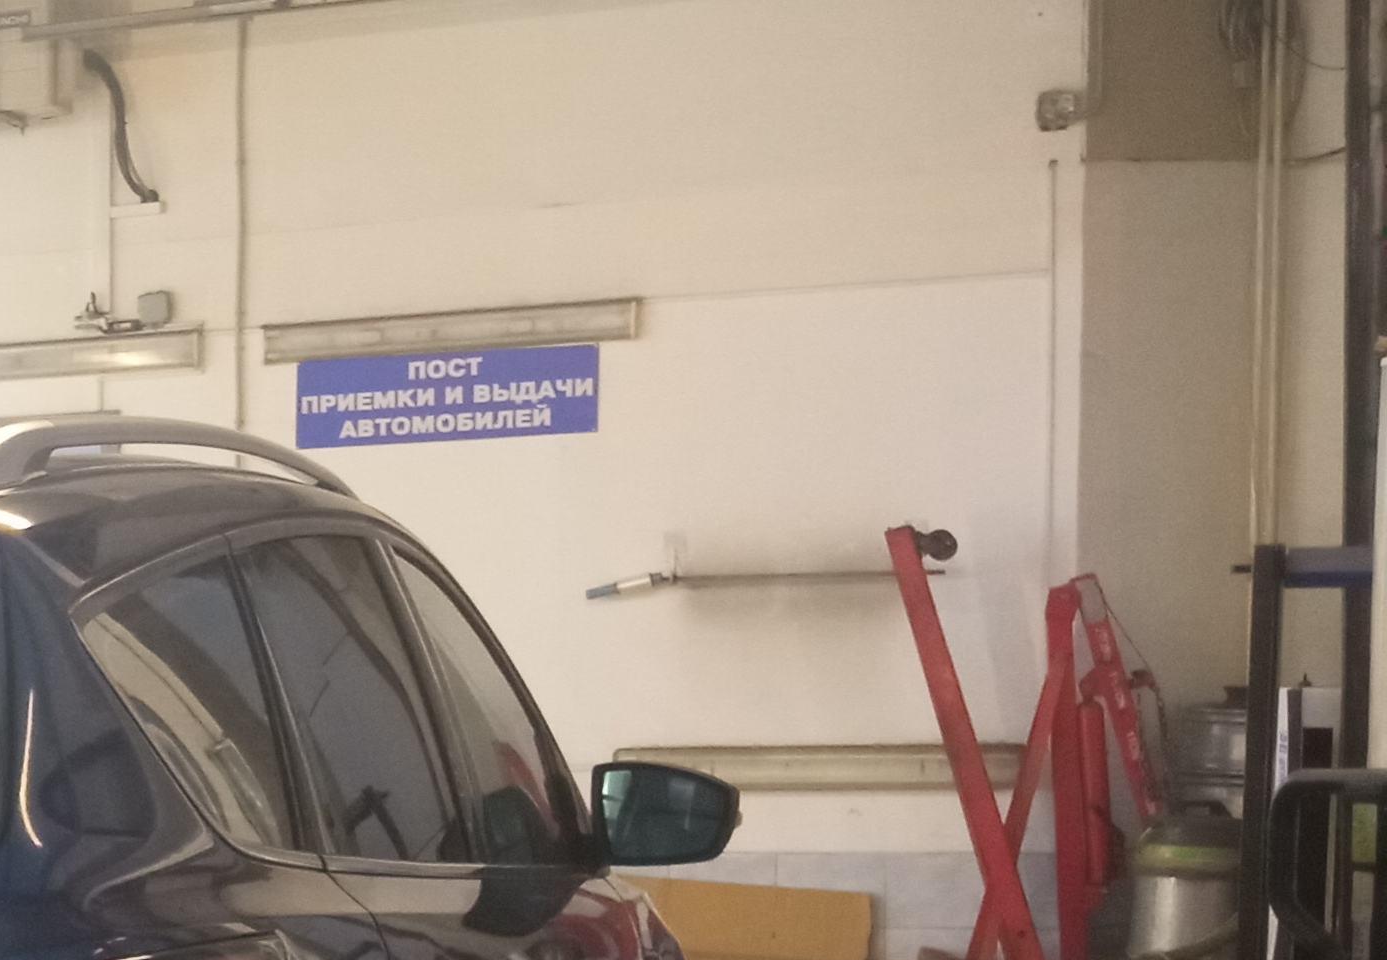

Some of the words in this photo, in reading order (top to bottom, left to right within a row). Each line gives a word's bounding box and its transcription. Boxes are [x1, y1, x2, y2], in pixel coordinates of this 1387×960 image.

[408, 357, 483, 380] ПОСТ
[300, 387, 435, 414] ПРИЕМКИ
[444, 385, 464, 405] И
[473, 378, 594, 404] ВЫДАЧИ
[339, 403, 552, 439] АВТОМОБИЛЕЙ
